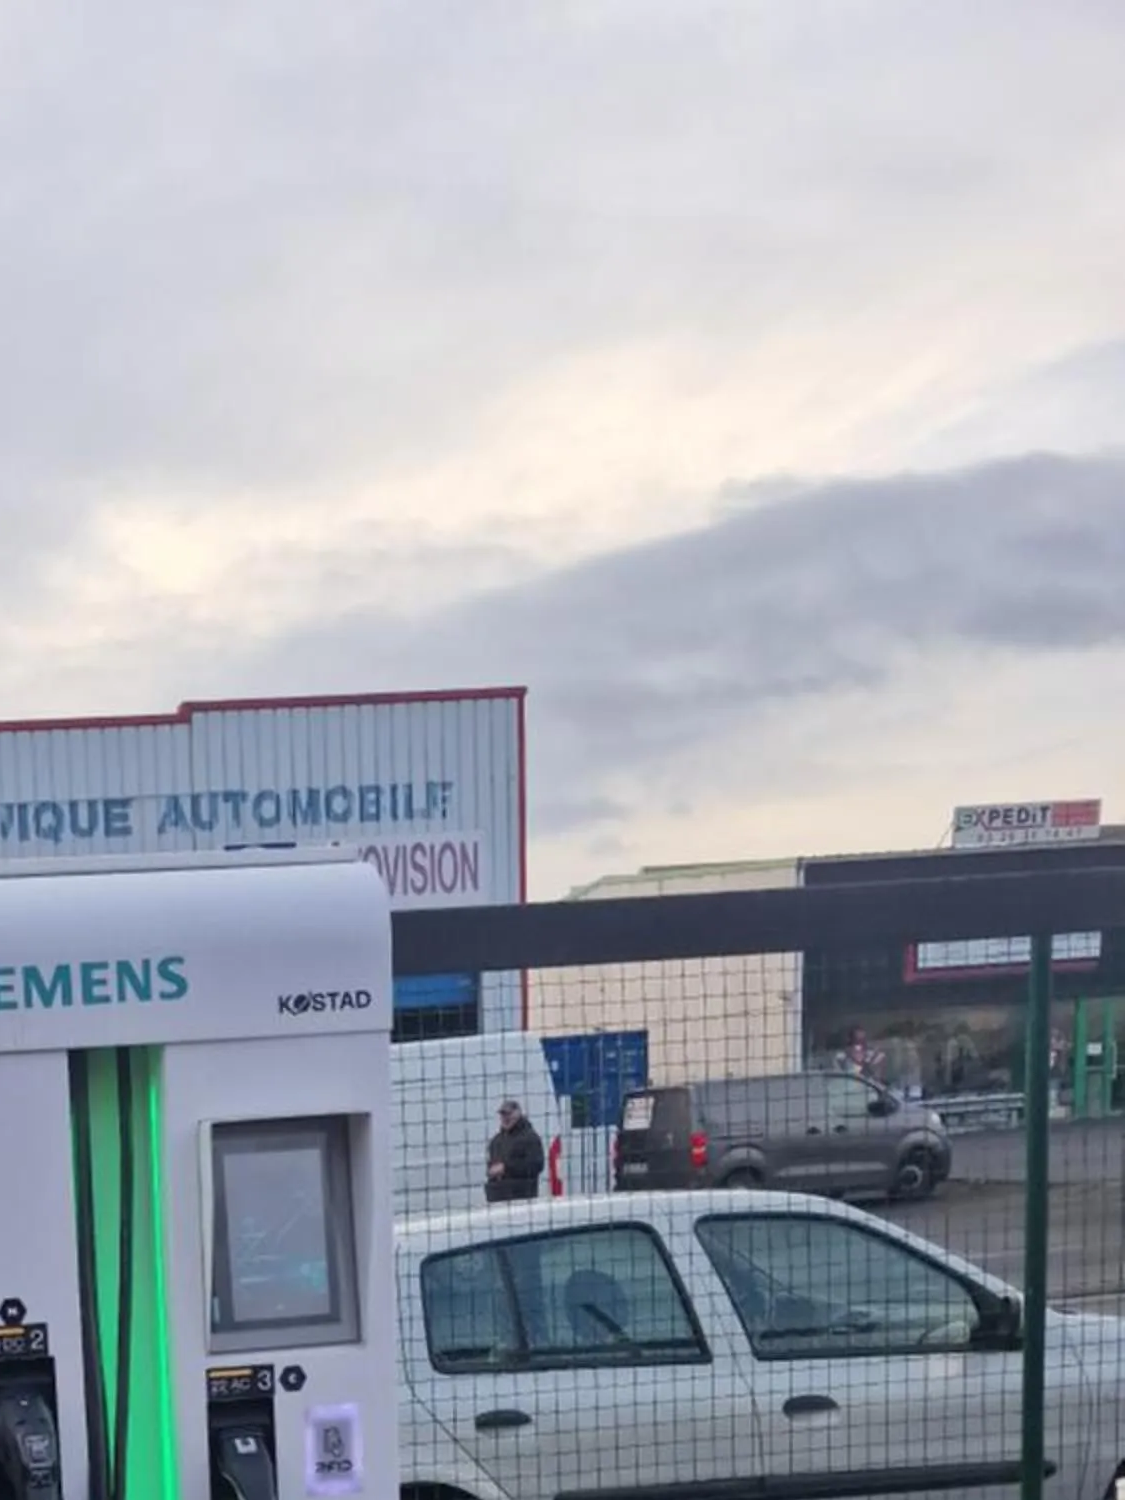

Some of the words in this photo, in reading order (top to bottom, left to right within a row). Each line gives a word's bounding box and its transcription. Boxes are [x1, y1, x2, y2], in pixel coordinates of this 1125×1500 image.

[158, 781, 453, 834] AUTOMOBILE
[358, 841, 480, 896] OVISION
[30, 1329, 45, 1350] 2
[257, 1369, 272, 1391] 3
